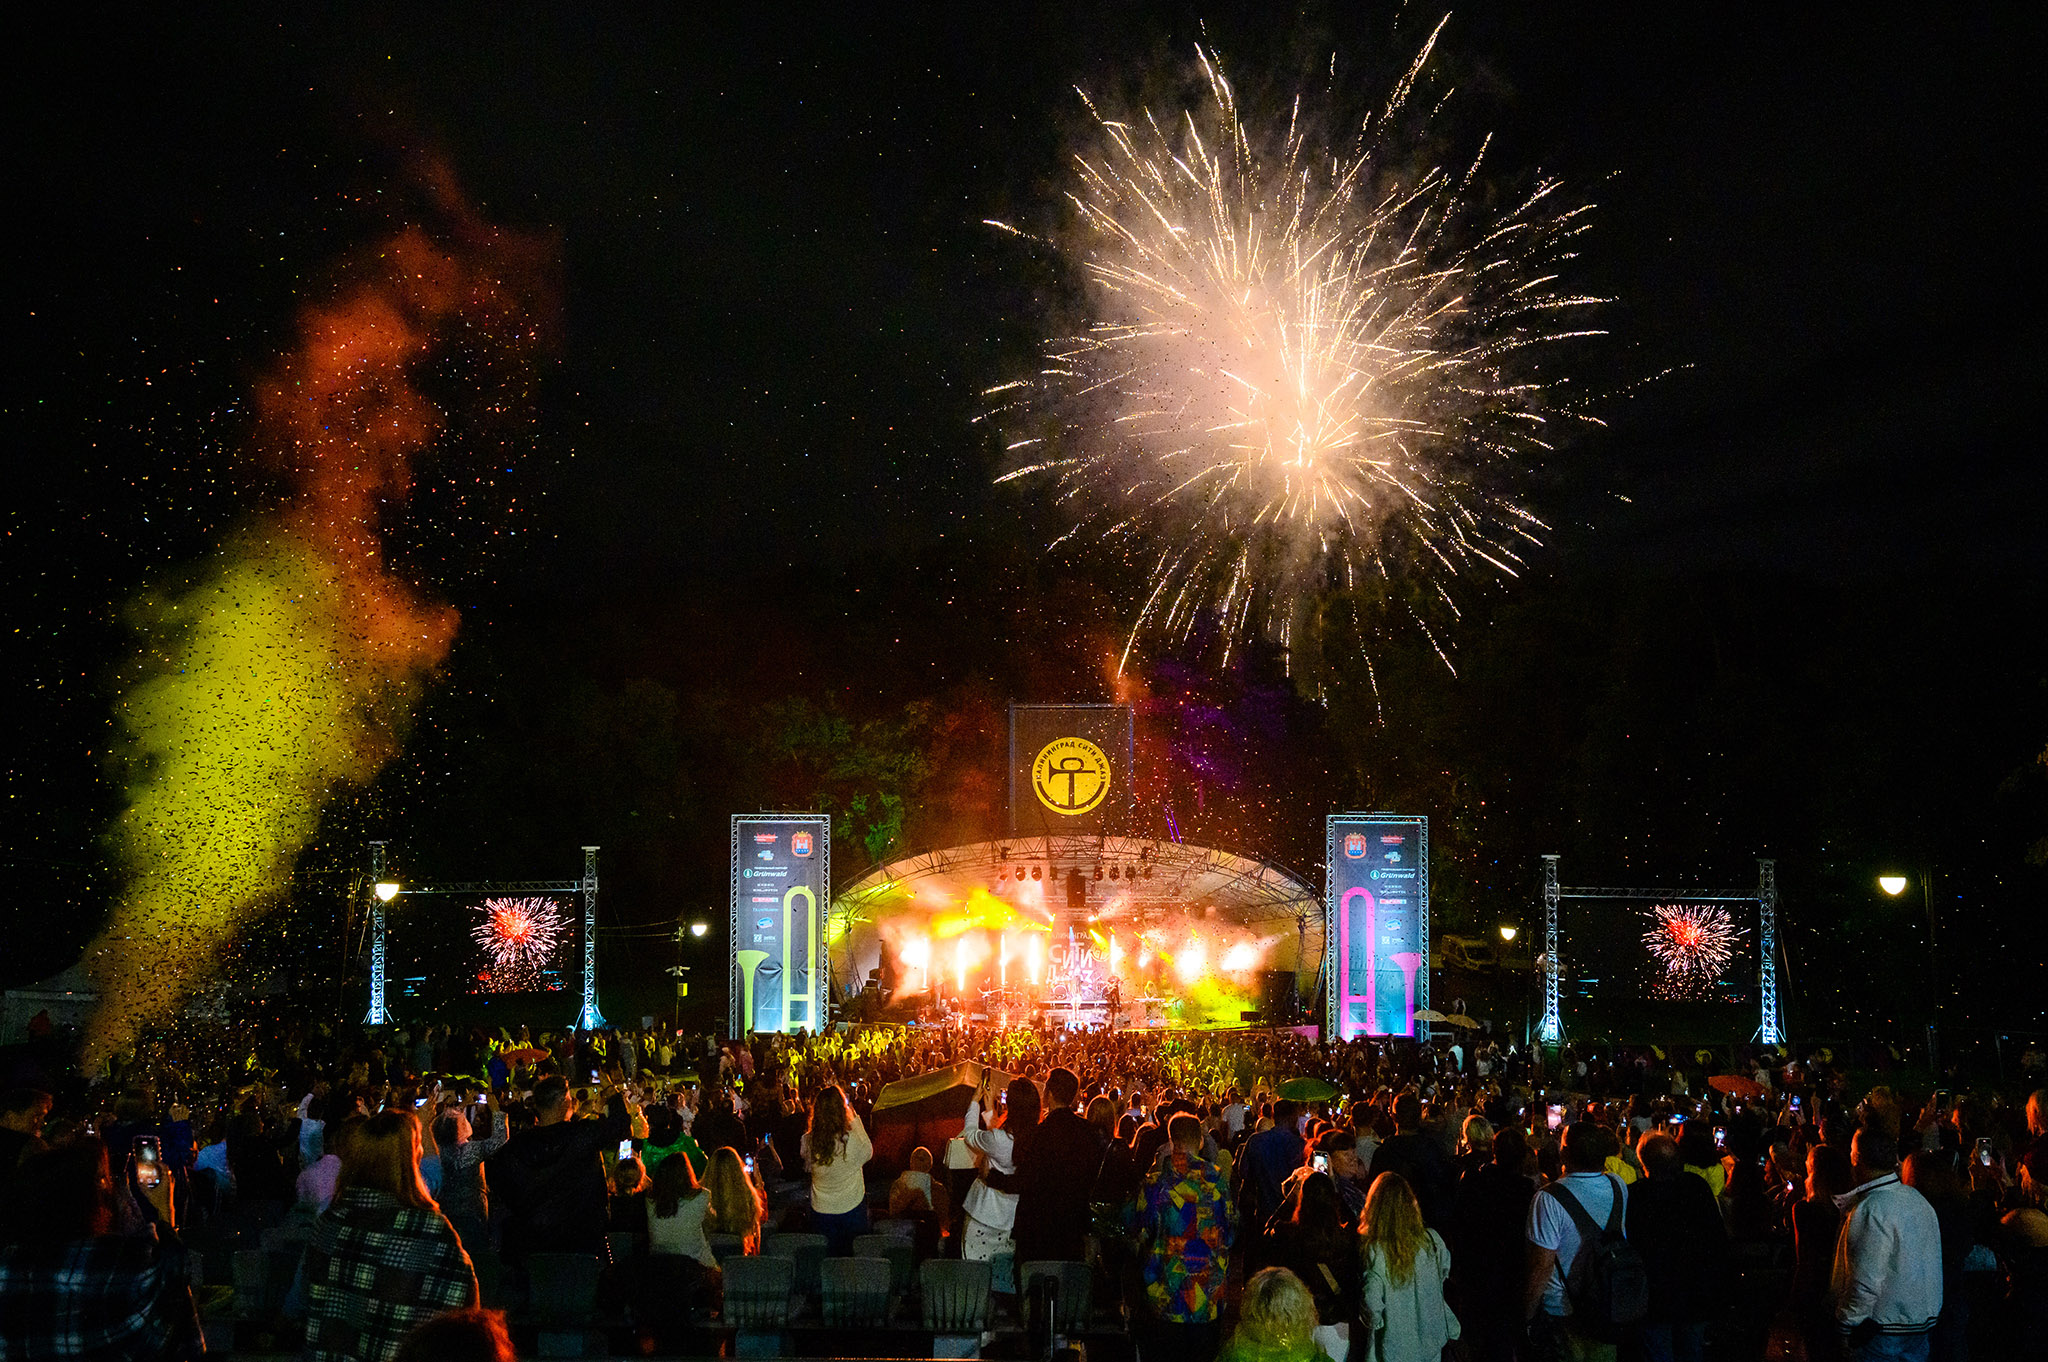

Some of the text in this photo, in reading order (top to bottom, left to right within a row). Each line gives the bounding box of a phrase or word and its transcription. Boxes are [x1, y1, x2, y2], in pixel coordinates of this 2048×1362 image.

[1036, 741, 1107, 780] КАЛИНИНГРАД СИТИ ДЖАЗ
[1380, 871, 1416, 879] Grünwald
[1048, 942, 1093, 970] СИТИ
